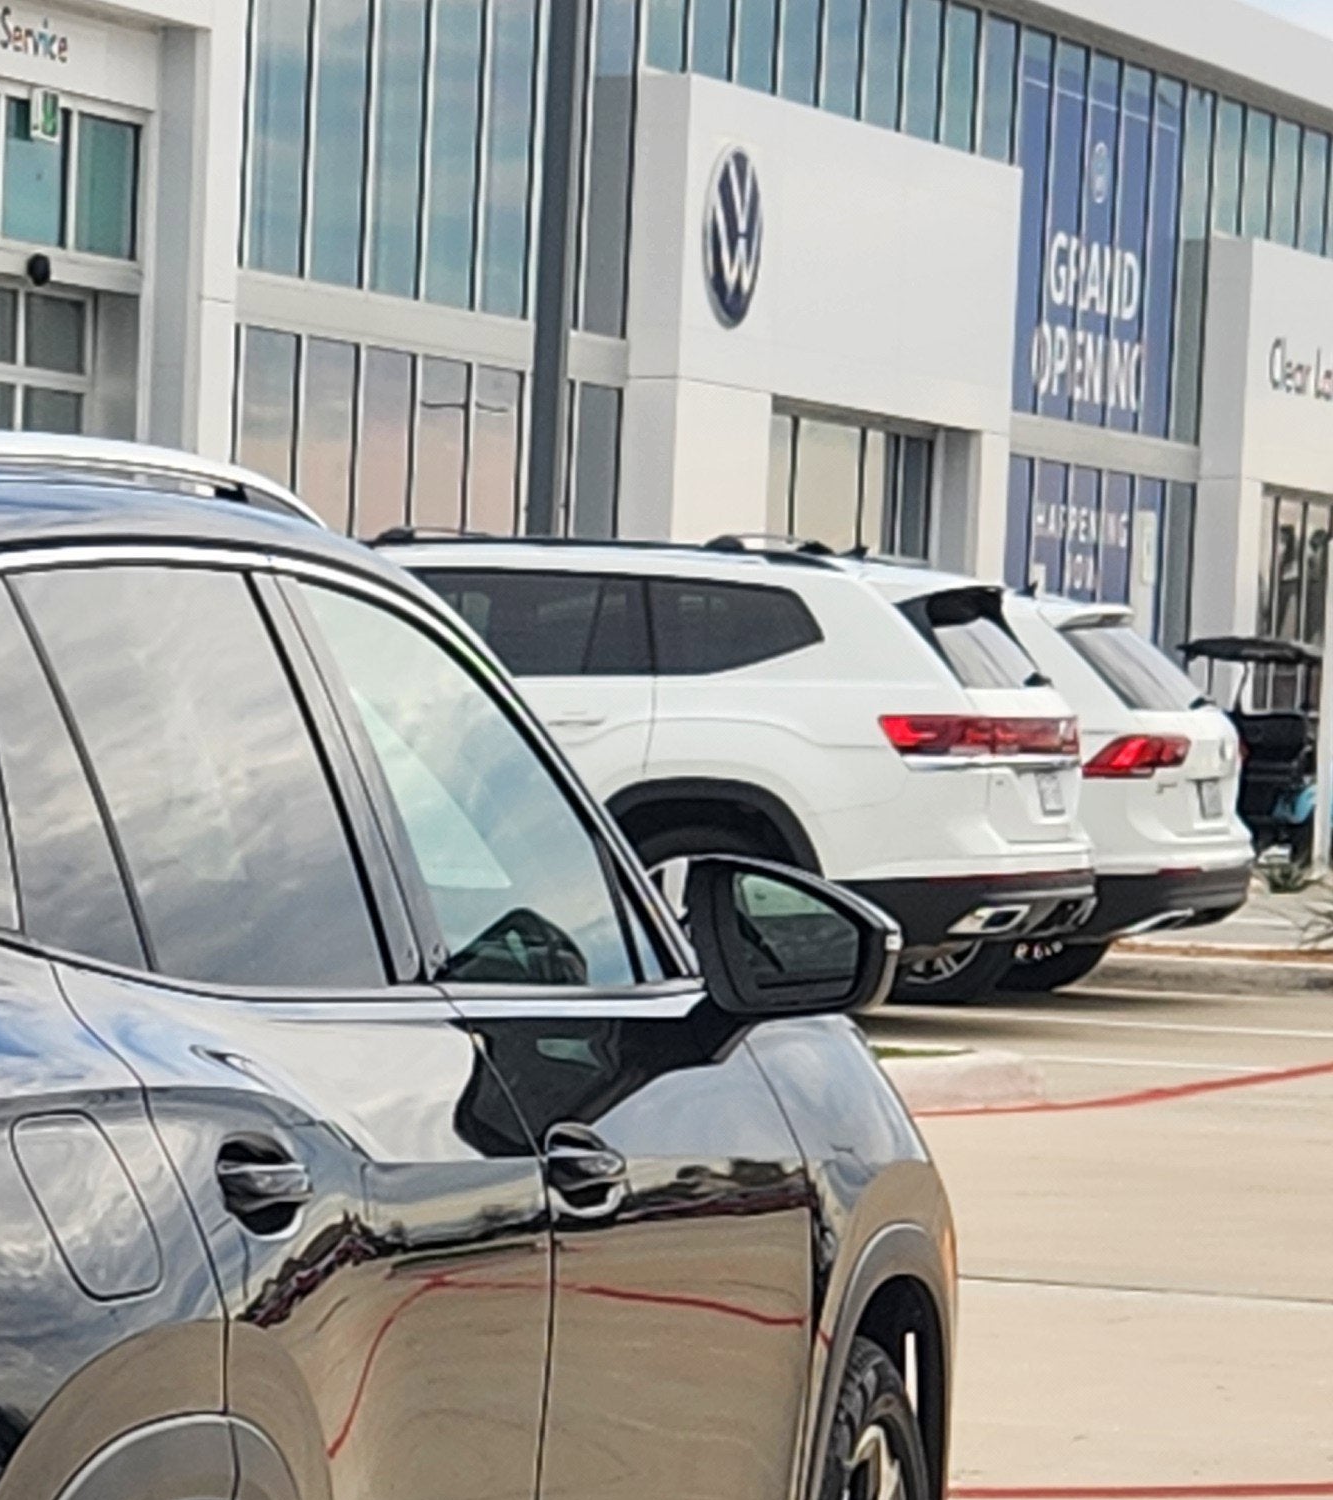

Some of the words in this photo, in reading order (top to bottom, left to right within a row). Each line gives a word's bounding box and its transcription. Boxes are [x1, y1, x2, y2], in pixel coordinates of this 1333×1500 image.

[0, 6, 68, 62] Service
[1048, 231, 1141, 321] GRAND
[1031, 319, 1145, 412] OPENNG
[1269, 337, 1312, 394] Clear
